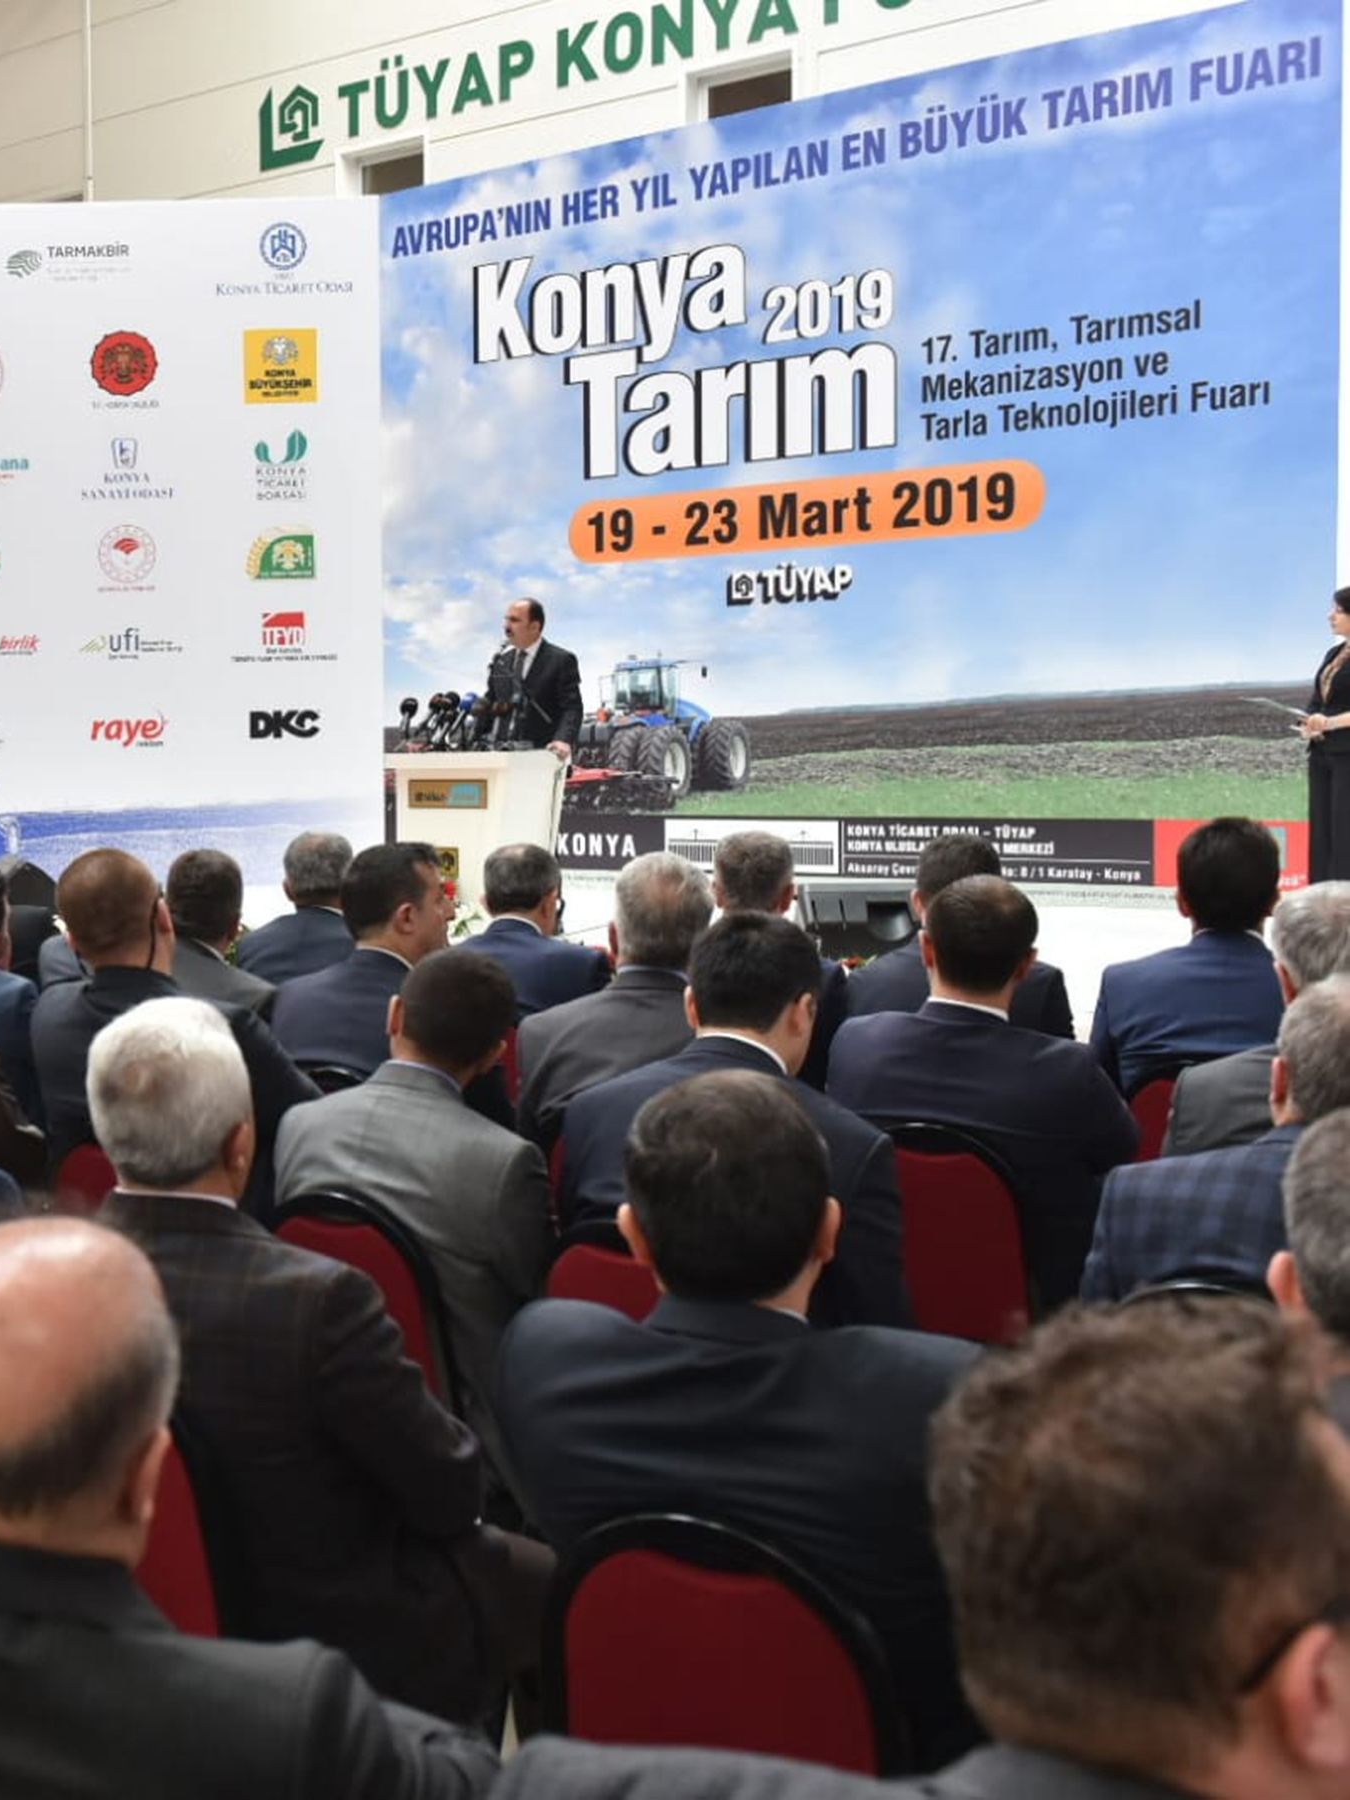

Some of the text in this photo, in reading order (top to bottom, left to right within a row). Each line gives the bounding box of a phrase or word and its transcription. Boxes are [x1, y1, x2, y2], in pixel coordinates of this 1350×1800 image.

[338, 0, 798, 138] TÜYAP KONYA
[391, 36, 1322, 258] AVRUPA'NIN HER YIL YAPILAN EN BÜYÜK TARIM FUARI
[47, 240, 130, 258] TARMAKBİR
[473, 243, 747, 365] Konya
[763, 269, 893, 345] 2019
[921, 299, 1202, 365] 17. Tarım, Tarımsal
[921, 350, 1169, 404] Mekanizasyon ve
[564, 341, 897, 480] Tarım
[920, 380, 1271, 442] Tarla Teknolojileri Fuarı
[103, 471, 150, 484] KONYA
[256, 466, 307, 476] KONYA
[587, 470, 1016, 554] 19 - 23 Mart 2019
[756, 560, 853, 605] TÜYAP
[109, 627, 139, 652] ufi
[91, 718, 164, 748] raye
[249, 709, 320, 739] DKC
[557, 835, 636, 858] KONYA
[847, 825, 886, 838] KONYA
[888, 823, 940, 838] TİCARET
[994, 823, 1036, 839] TÜYAP
[847, 840, 884, 852] KONYA
[1002, 841, 1055, 855] MERKEZİ
[847, 862, 889, 877] Aksaray
[1037, 867, 1044, 877] 1
[1047, 867, 1093, 882] Karatay
[1104, 867, 1142, 883] Konya
